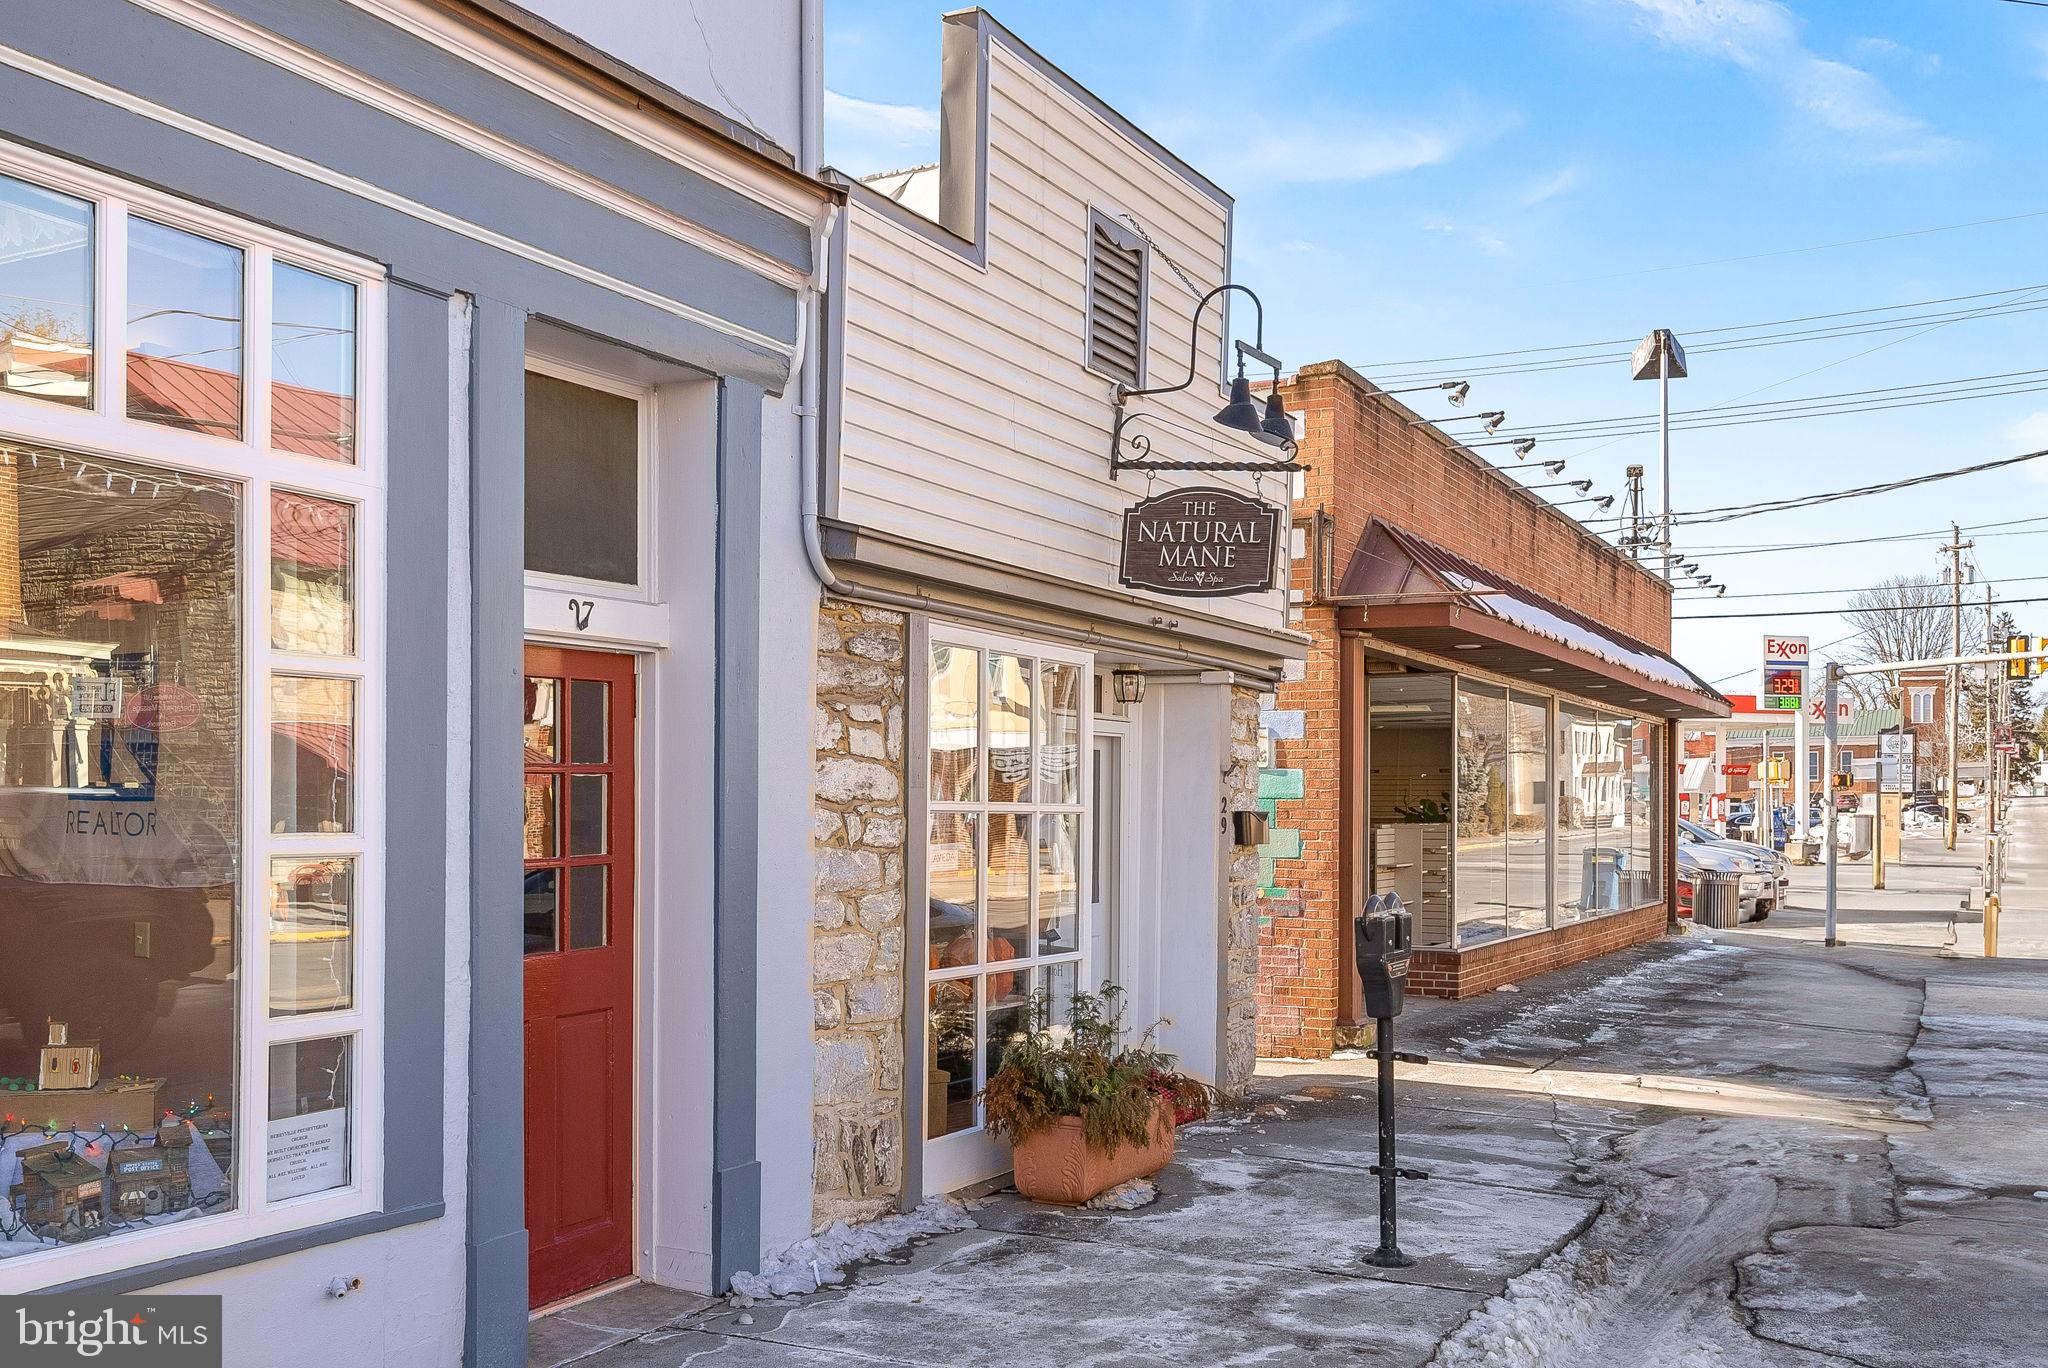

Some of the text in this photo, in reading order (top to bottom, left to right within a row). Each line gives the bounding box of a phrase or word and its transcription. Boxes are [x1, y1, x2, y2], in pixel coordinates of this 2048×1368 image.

[1182, 501, 1216, 516] THE
[1137, 521, 1261, 543] NATURAL
[1158, 545, 1236, 568] MANE
[1168, 571, 1224, 586] Salon Spa
[1767, 639, 1807, 659] Exxon
[66, 810, 157, 836] REALTOR
